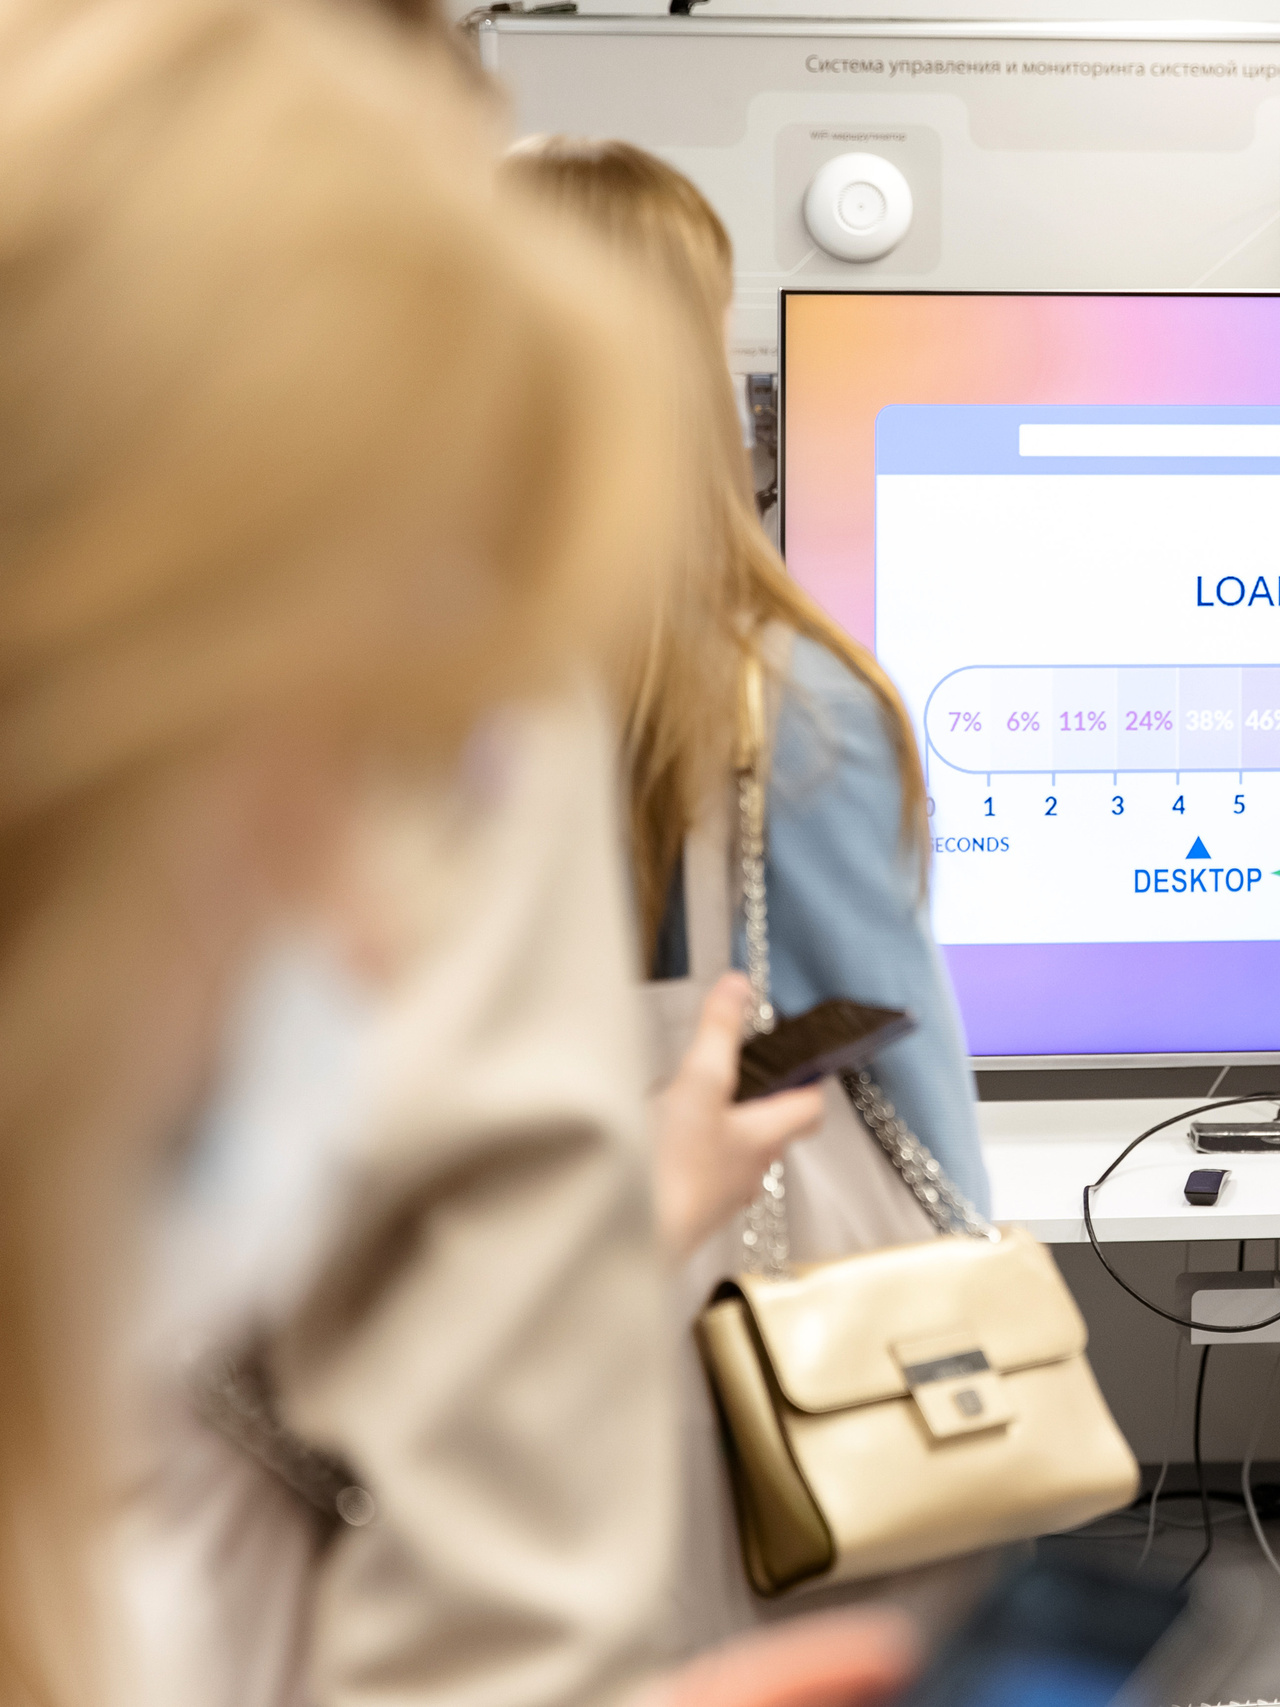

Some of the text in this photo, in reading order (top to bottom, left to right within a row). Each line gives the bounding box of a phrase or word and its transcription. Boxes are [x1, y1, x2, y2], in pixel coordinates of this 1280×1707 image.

[805, 53, 885, 75] Система
[888, 58, 1002, 79] управления
[1004, 61, 1018, 75] и
[1021, 61, 1146, 79] мониторинга
[1149, 60, 1238, 79] системой
[948, 711, 982, 732] 7%
[1006, 711, 1040, 732] 6%
[1059, 710, 1107, 732] 11%
[1125, 710, 1173, 731] 24%
[1185, 709, 1235, 731] 38%
[984, 796, 996, 817] 1
[1044, 795, 1058, 816] 2
[1111, 795, 1125, 816] 3
[1171, 794, 1186, 815] 4
[1233, 794, 1246, 815] 5
[1134, 867, 1262, 894] DESKTOP
